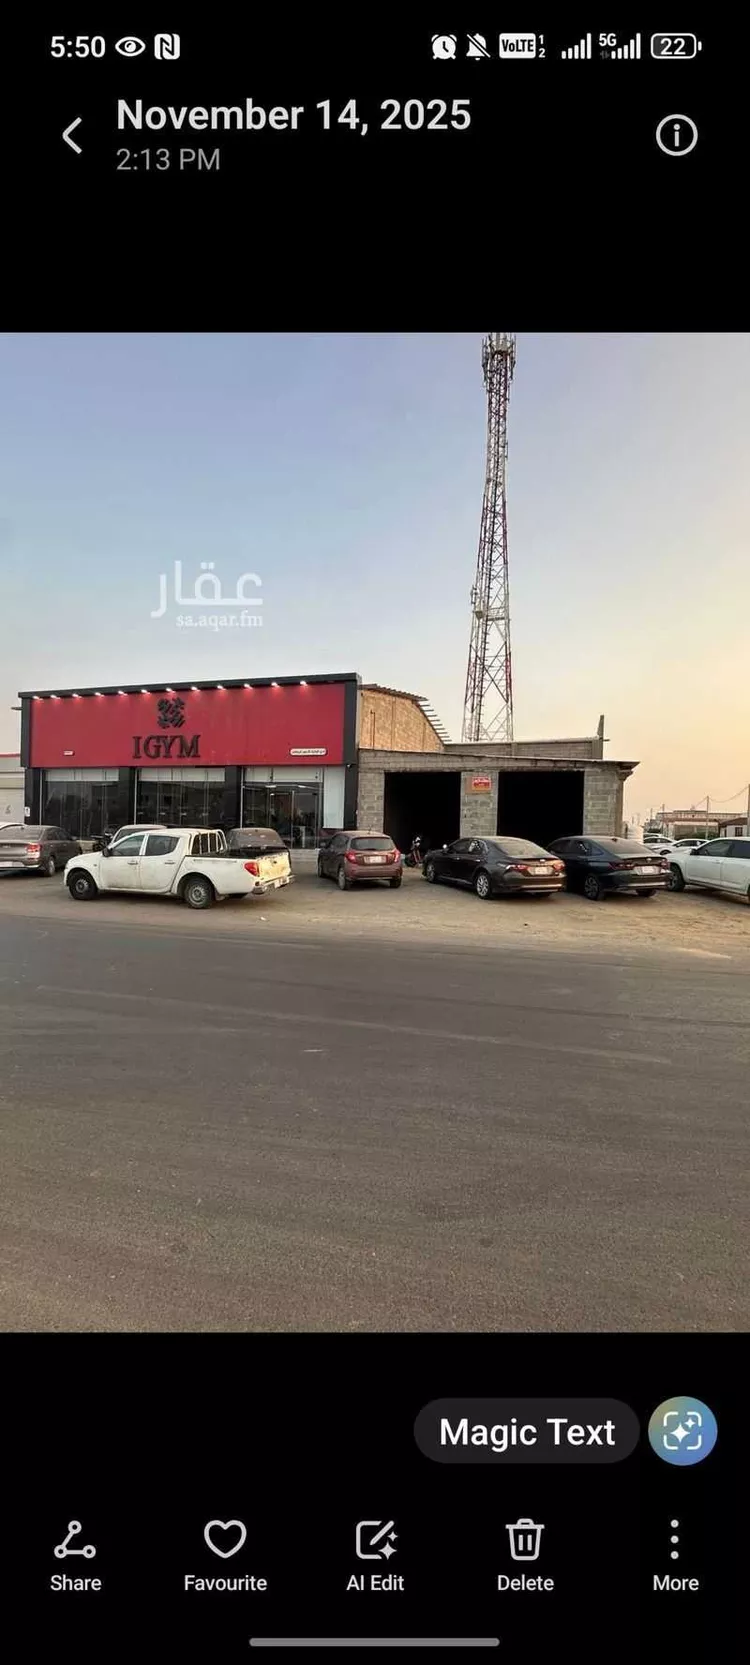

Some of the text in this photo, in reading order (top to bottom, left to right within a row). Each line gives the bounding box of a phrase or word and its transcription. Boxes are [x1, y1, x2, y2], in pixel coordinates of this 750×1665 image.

[51, 36, 105, 57] 5:50
[501, 39, 534, 53] VoLTE
[598, 33, 617, 46] 5G
[660, 37, 686, 55] 22
[117, 98, 471, 135] November 14, 2025
[116, 148, 220, 170] 2:13 PM
[440, 1417, 616, 1453] Magic Text
[50, 1573, 102, 1591] Share
[184, 1574, 268, 1591] Favourite
[346, 1574, 405, 1591] AI Edit
[497, 1574, 555, 1591] Delete
[653, 1574, 700, 1591] More
